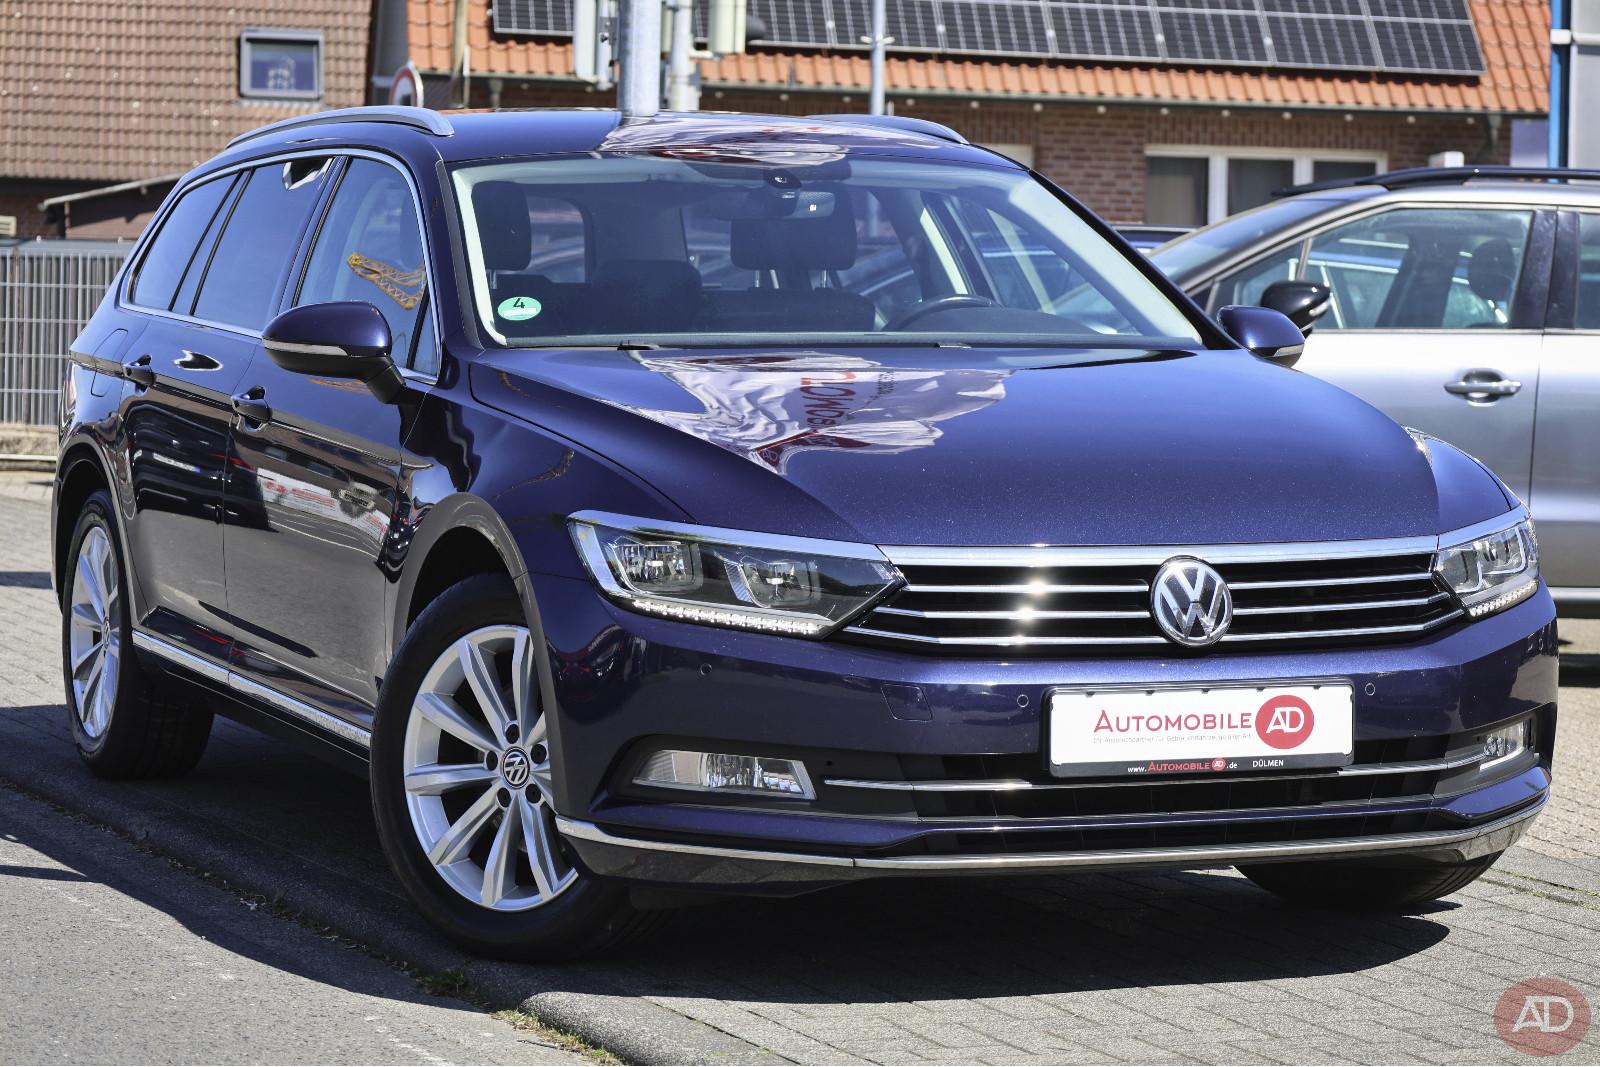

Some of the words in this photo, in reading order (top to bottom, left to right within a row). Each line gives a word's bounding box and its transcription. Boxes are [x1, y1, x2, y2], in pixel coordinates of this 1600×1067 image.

[513, 298, 526, 309] 4
[1094, 709, 1252, 733] AUTOMOBILE
[1266, 706, 1305, 734] AD
[1252, 759, 1284, 768] DÜLMEN
